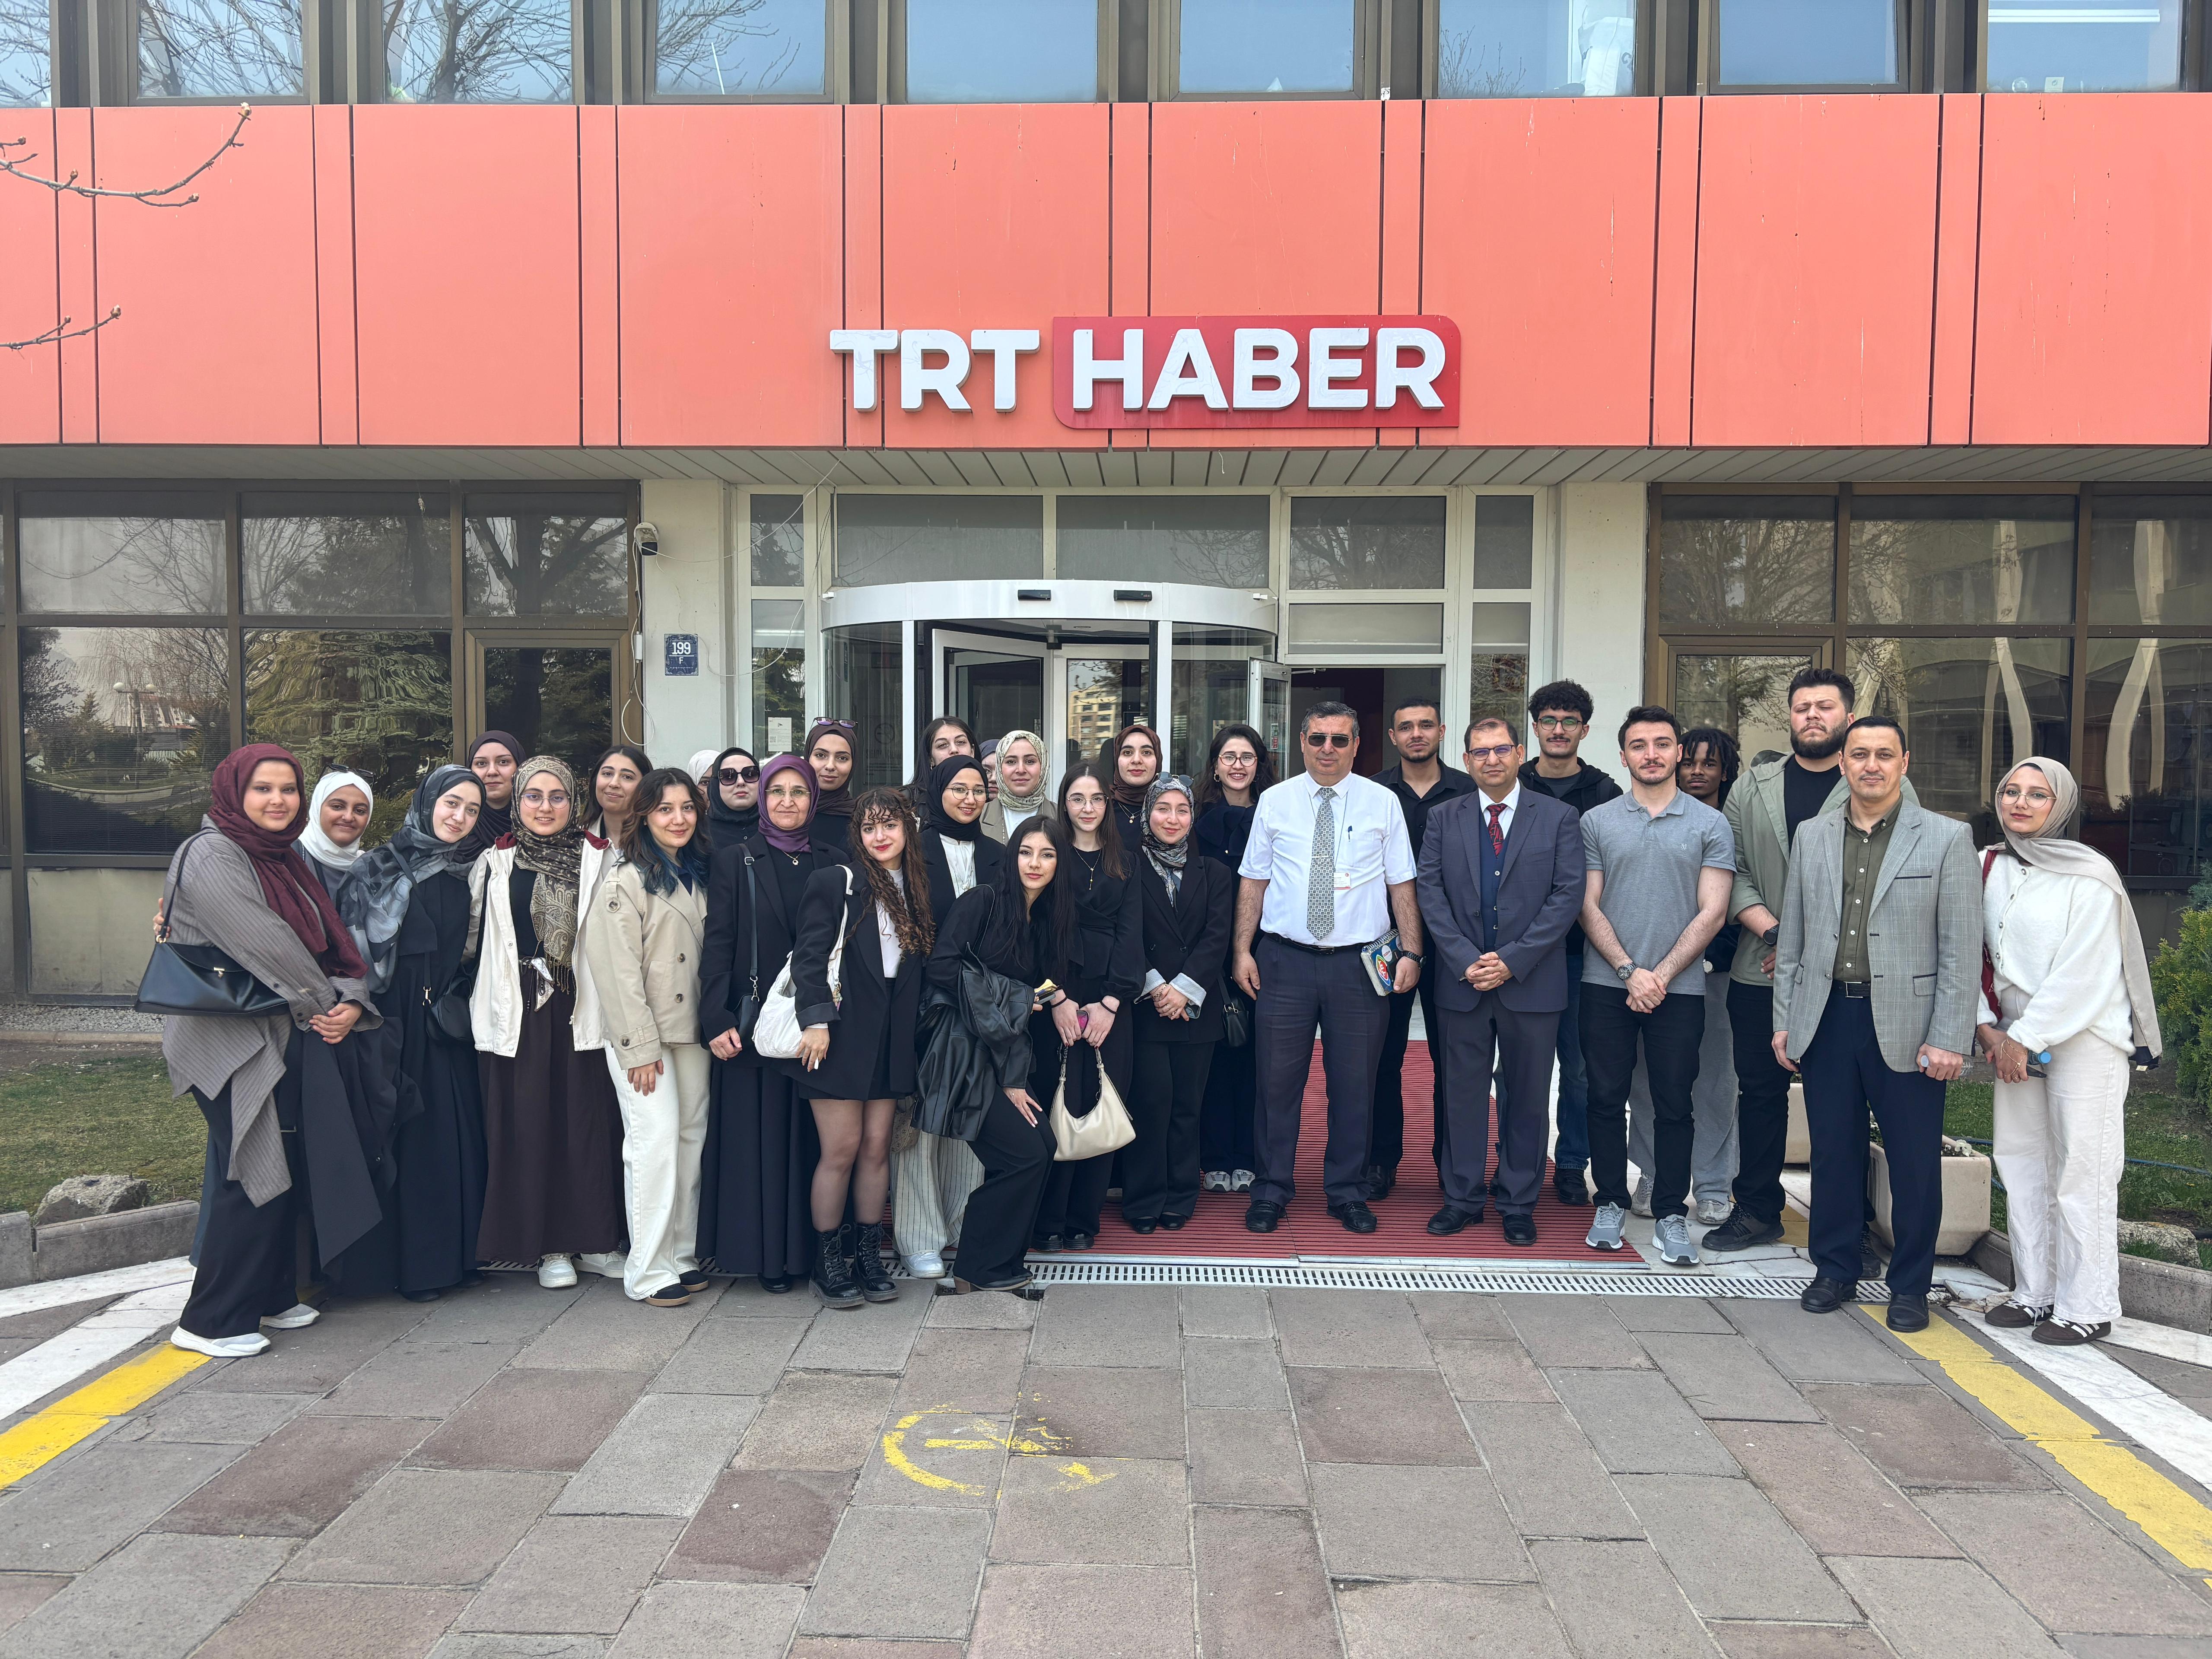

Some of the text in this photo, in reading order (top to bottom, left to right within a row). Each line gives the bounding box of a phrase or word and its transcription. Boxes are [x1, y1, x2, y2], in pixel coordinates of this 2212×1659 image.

[830, 327, 1446, 412] TRT HABER
[672, 642, 691, 655] 199
[1378, 960, 1386, 976] TRT
